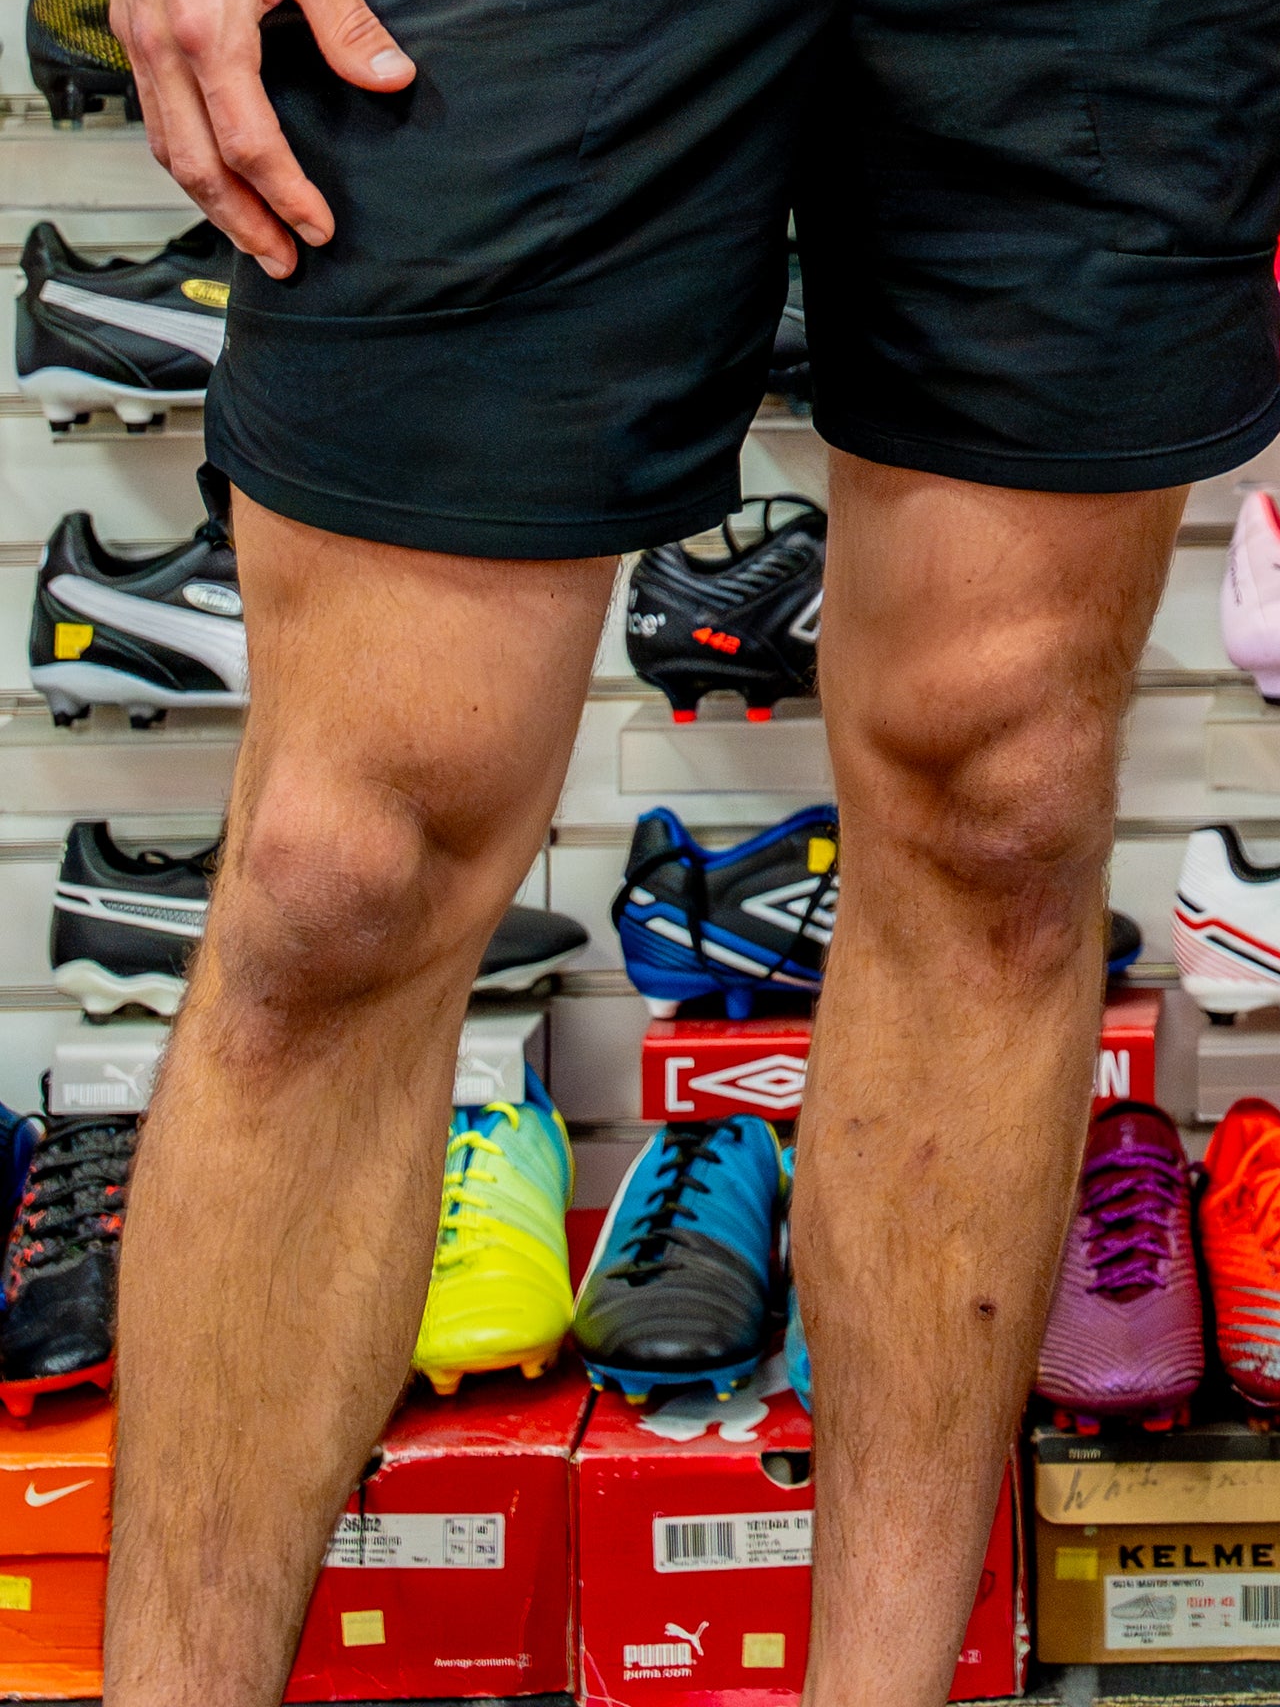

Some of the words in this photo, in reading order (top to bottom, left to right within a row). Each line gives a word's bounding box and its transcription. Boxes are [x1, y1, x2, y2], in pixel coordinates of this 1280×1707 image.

[1119, 1543, 1275, 1570] KELME
[623, 1643, 692, 1669] PUMA
[623, 1667, 693, 1682] puma.com
